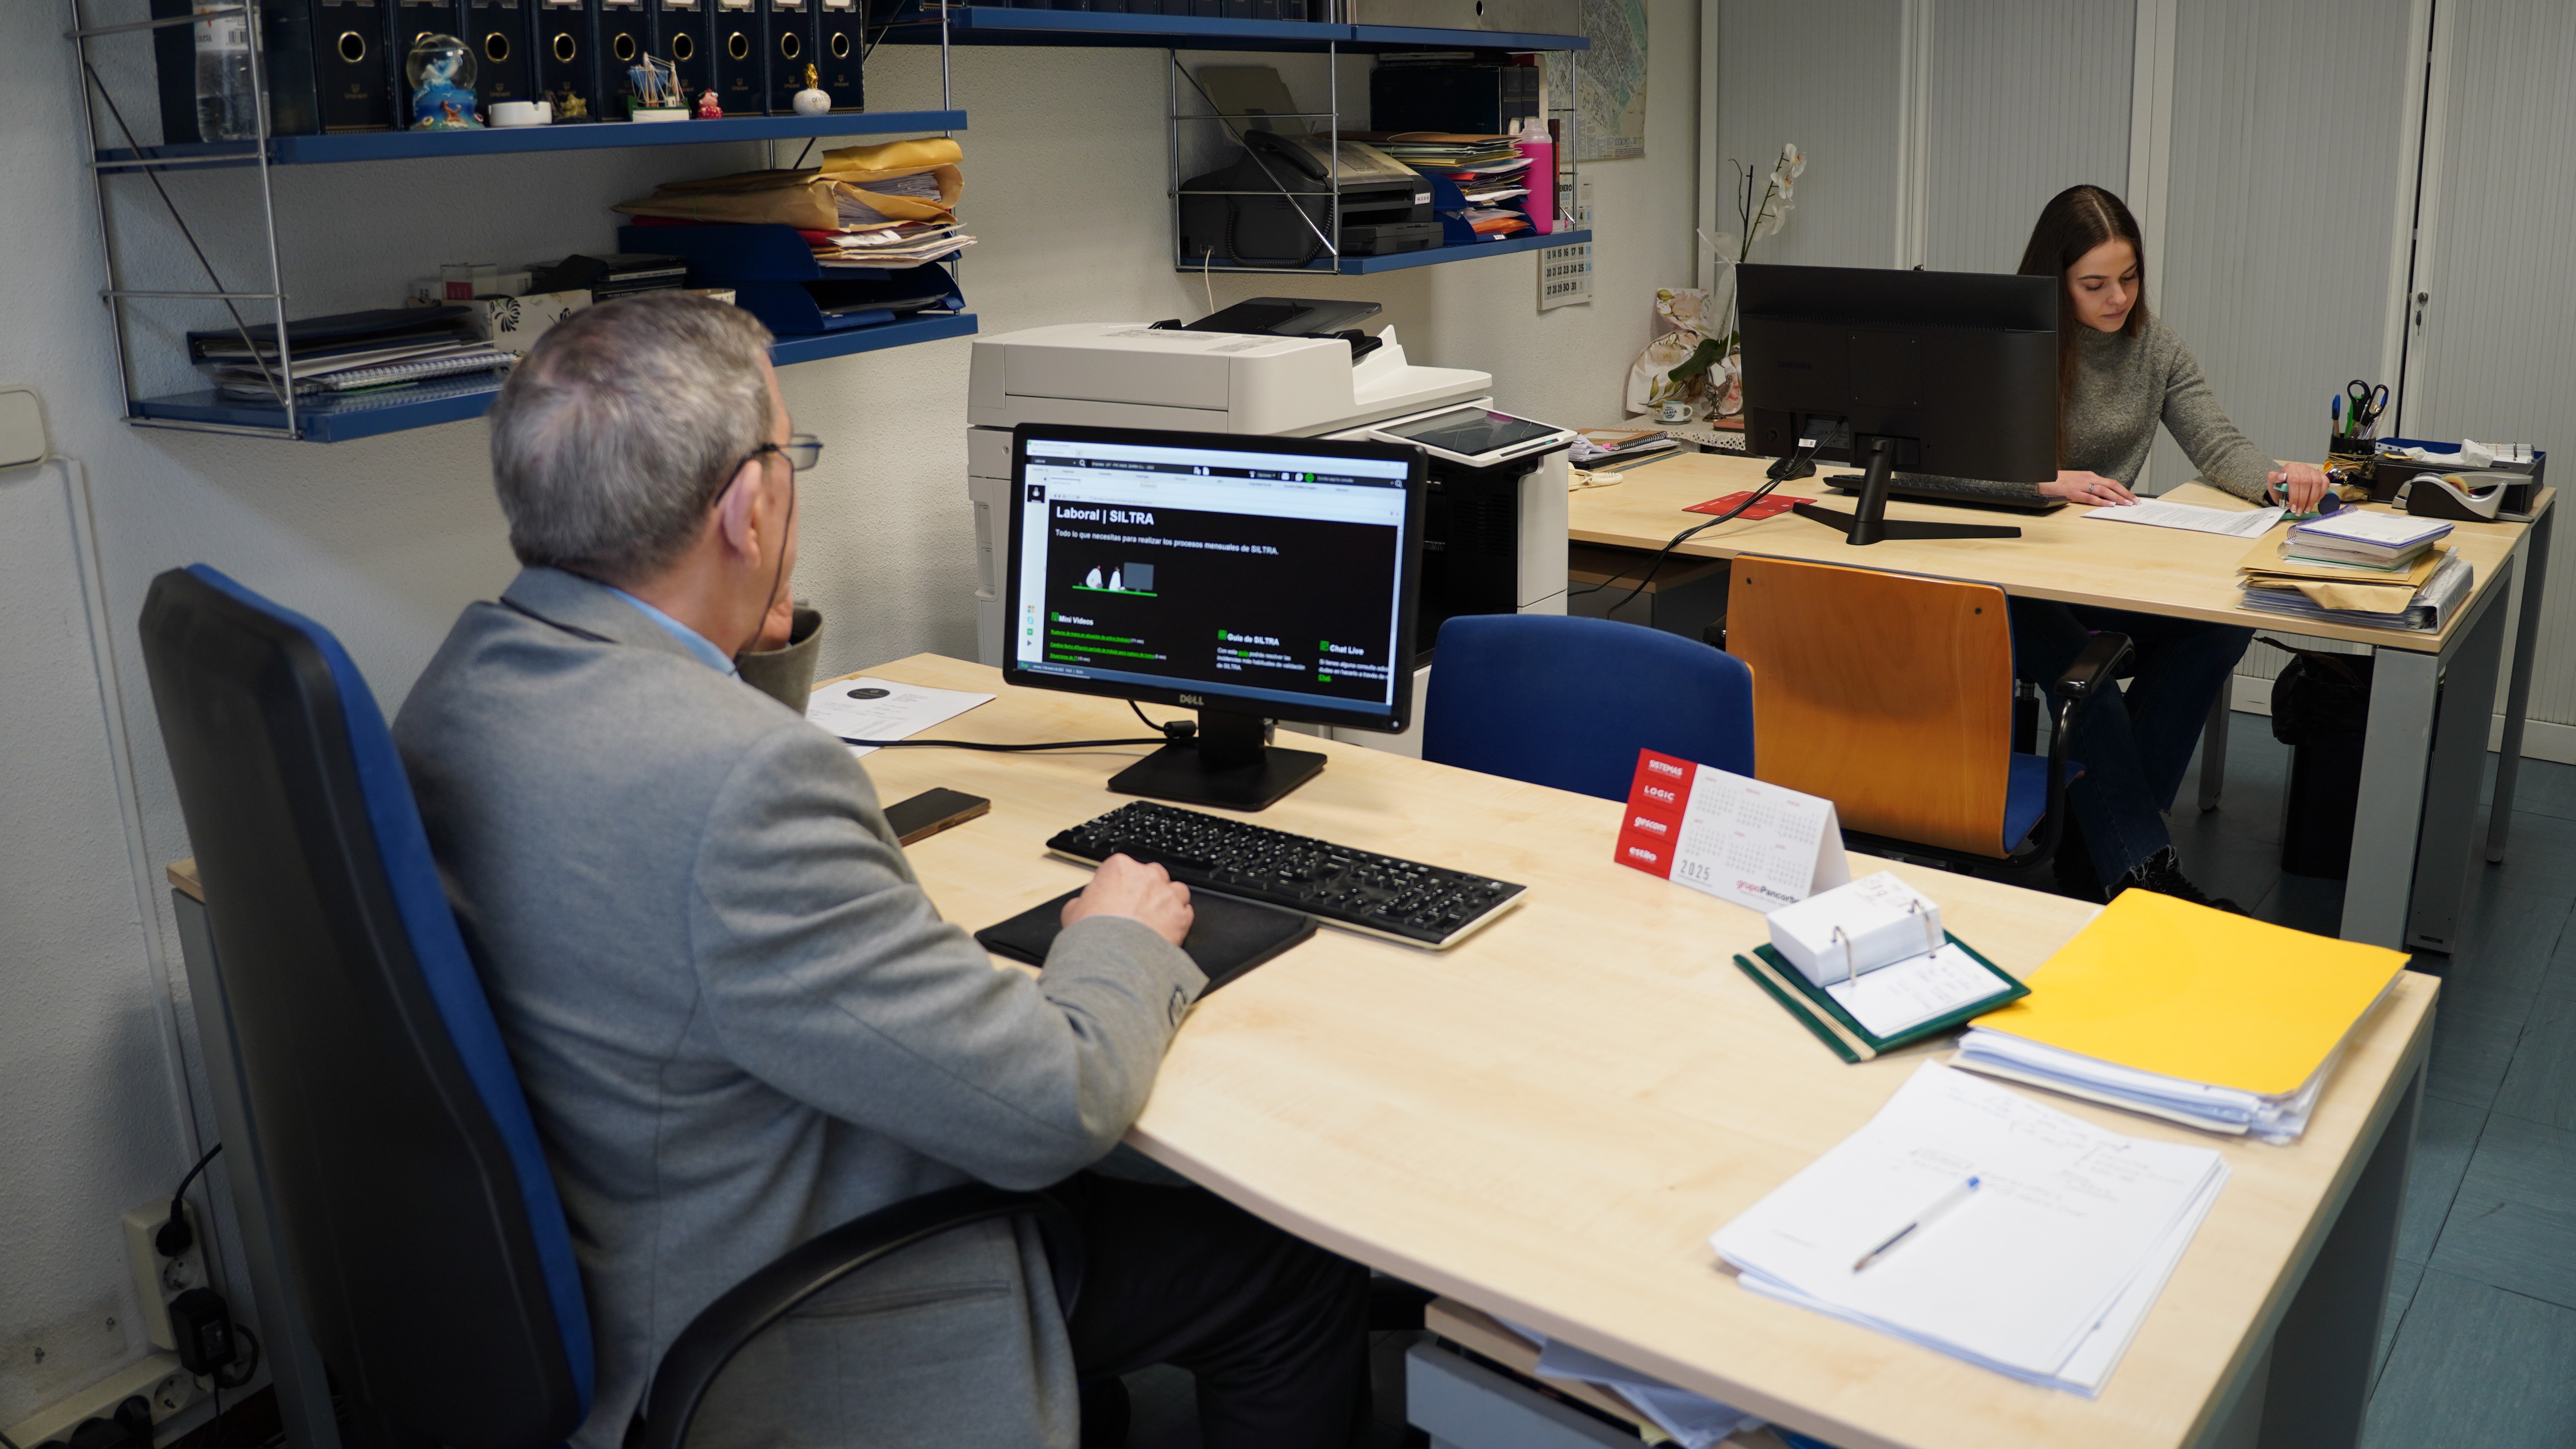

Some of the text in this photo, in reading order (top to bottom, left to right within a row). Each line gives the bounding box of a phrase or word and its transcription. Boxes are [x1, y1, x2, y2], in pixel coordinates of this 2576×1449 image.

[1580, 212, 1590, 220] 4 5
[1547, 246, 1591, 259] 13 14 15 16 17 18 19
[1546, 263, 1592, 277] 20 21 22 23 24 25 26
[1547, 286, 1551, 295] 27
[1552, 285, 1557, 294] 28
[1558, 284, 1562, 293] 29
[1563, 283, 1569, 292] 30
[1571, 282, 1576, 290] 31
[1777, 361, 1812, 370] SAMSUNG
[1057, 506, 1100, 521] Laboral
[1109, 509, 1154, 525] SILTRA
[1055, 529, 1071, 537] Todo
[1092, 533, 1121, 541] necesitas
[1138, 536, 1162, 545] realizar
[1163, 538, 1173, 546] los
[1173, 540, 1203, 548] procesos
[1204, 543, 1240, 552] mensuales
[1240, 544, 1250, 553] de
[1059, 615, 1072, 623] Mini
[1244, 635, 1253, 644] de
[1254, 636, 1279, 646] SILTRA
[1330, 644, 1364, 655] Chat Live
[1179, 694, 1204, 705] DELL
[1649, 759, 1683, 776] SISTEMAS
[1643, 785, 1675, 801] LOGIC
[1634, 817, 1667, 832] gescom
[1629, 847, 1657, 862] estilo
[1680, 859, 1710, 881] 2025
